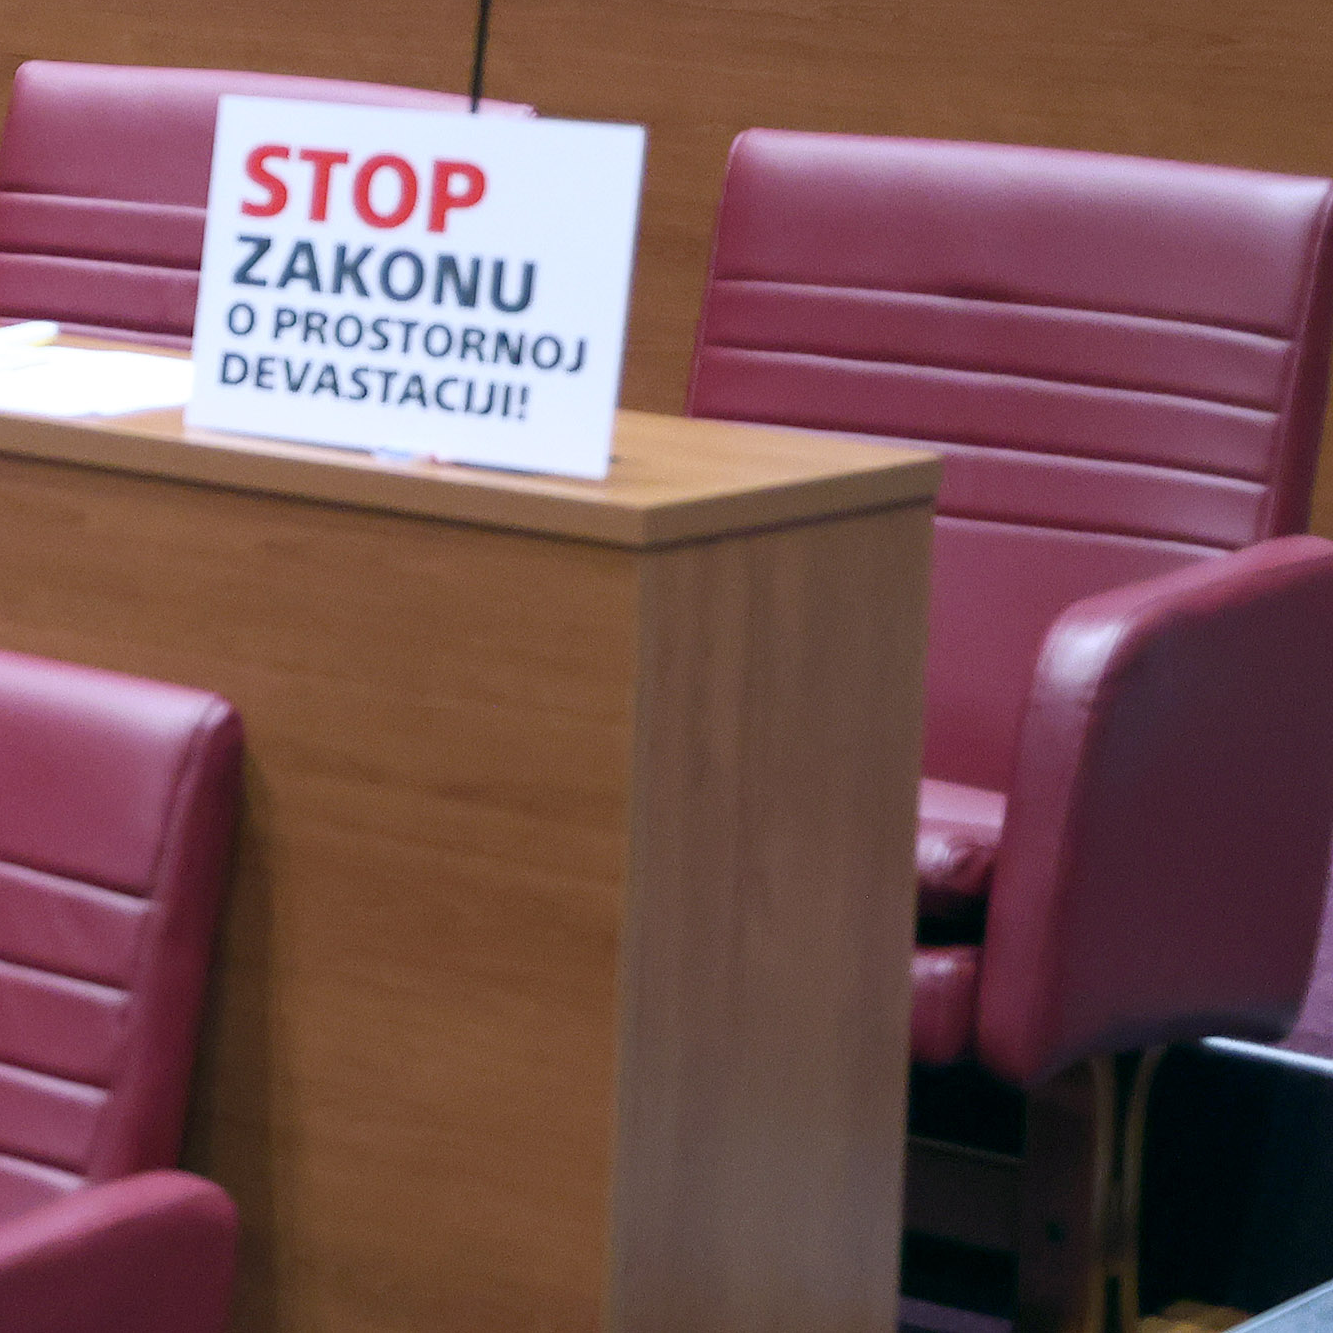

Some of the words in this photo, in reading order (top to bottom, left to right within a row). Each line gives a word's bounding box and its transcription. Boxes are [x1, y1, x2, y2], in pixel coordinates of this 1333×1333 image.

[240, 143, 488, 234] STOP
[232, 234, 537, 313] ZAKONU
[228, 302, 256, 336] O
[273, 307, 587, 373] PROSTORNOJ
[219, 351, 529, 421] DEVASTACIJI!
